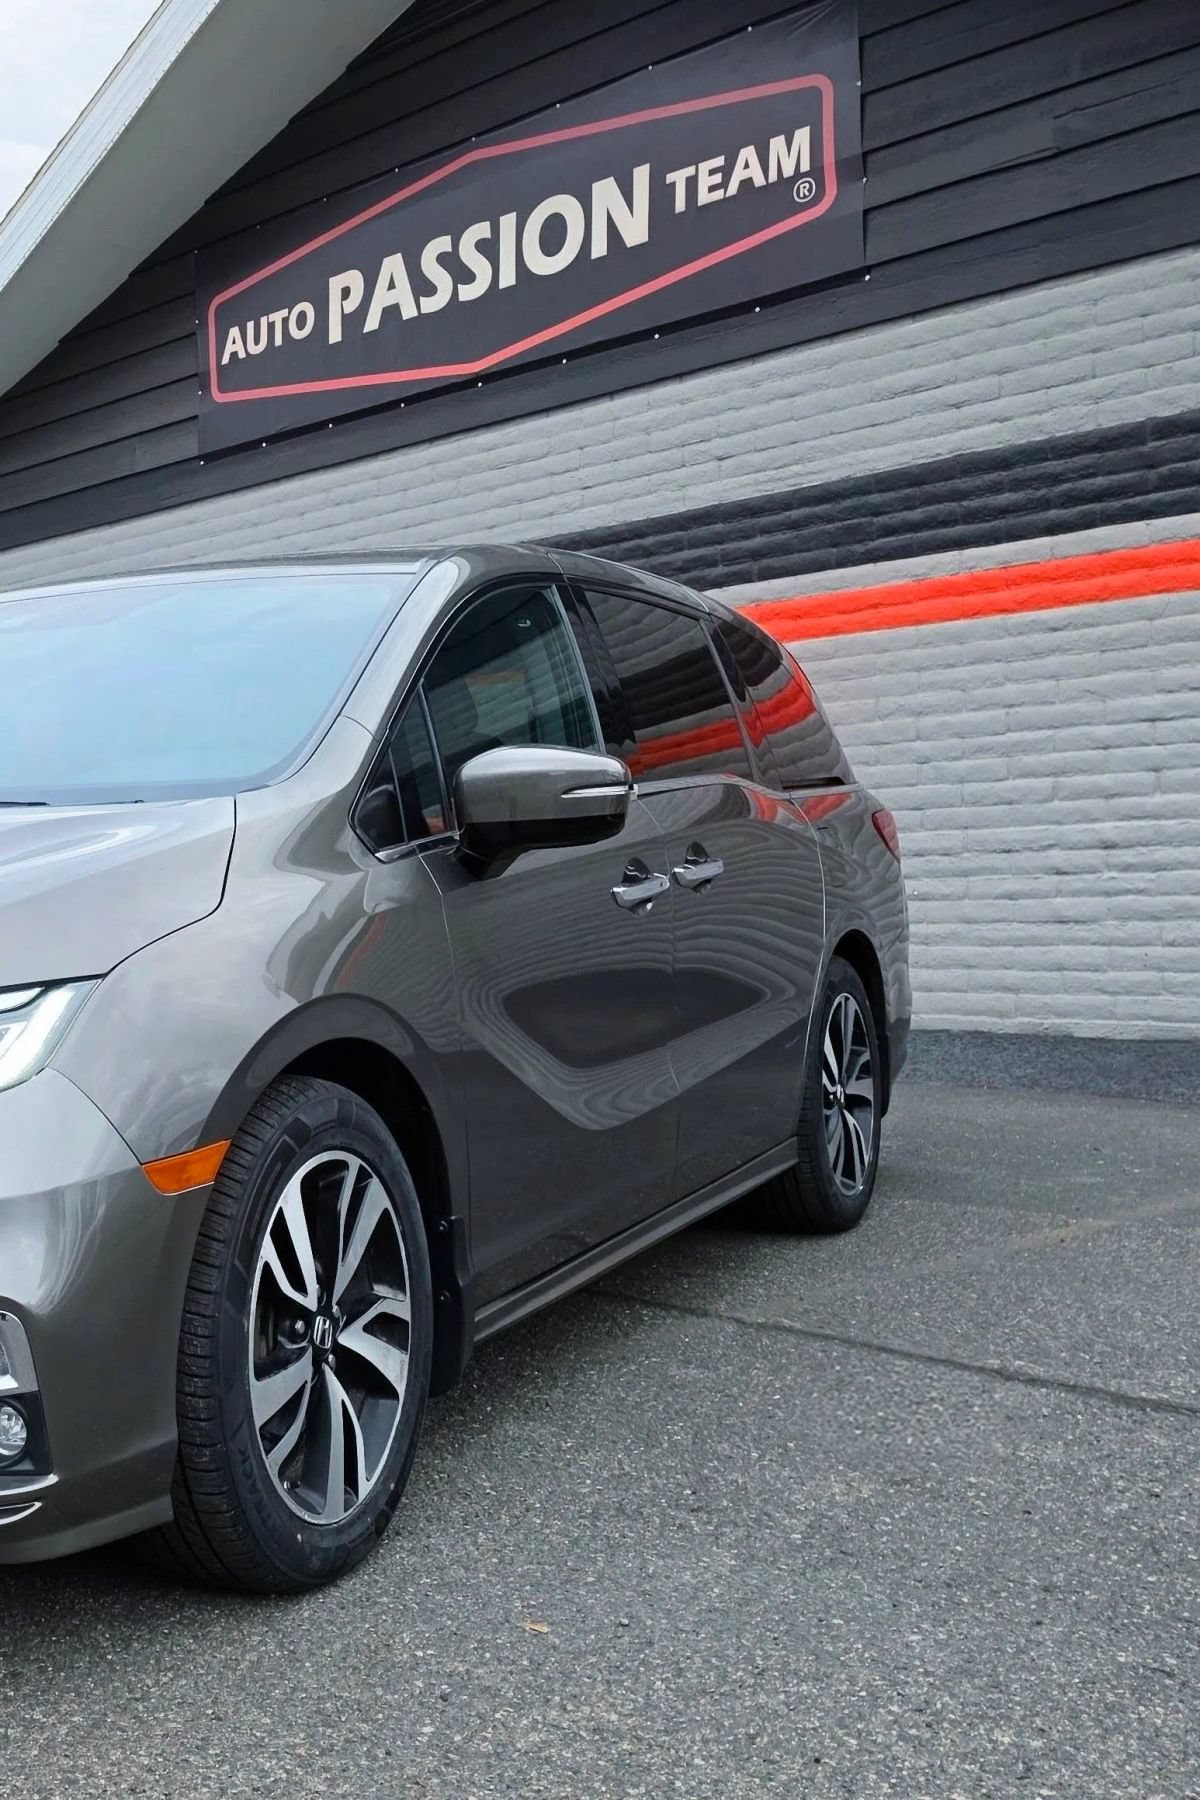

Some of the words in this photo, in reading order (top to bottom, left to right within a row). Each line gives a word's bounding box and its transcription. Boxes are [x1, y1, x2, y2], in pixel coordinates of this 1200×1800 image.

[221, 300, 315, 365] AUTO
[327, 163, 651, 345] PASSION
[665, 125, 811, 214] TEAM
